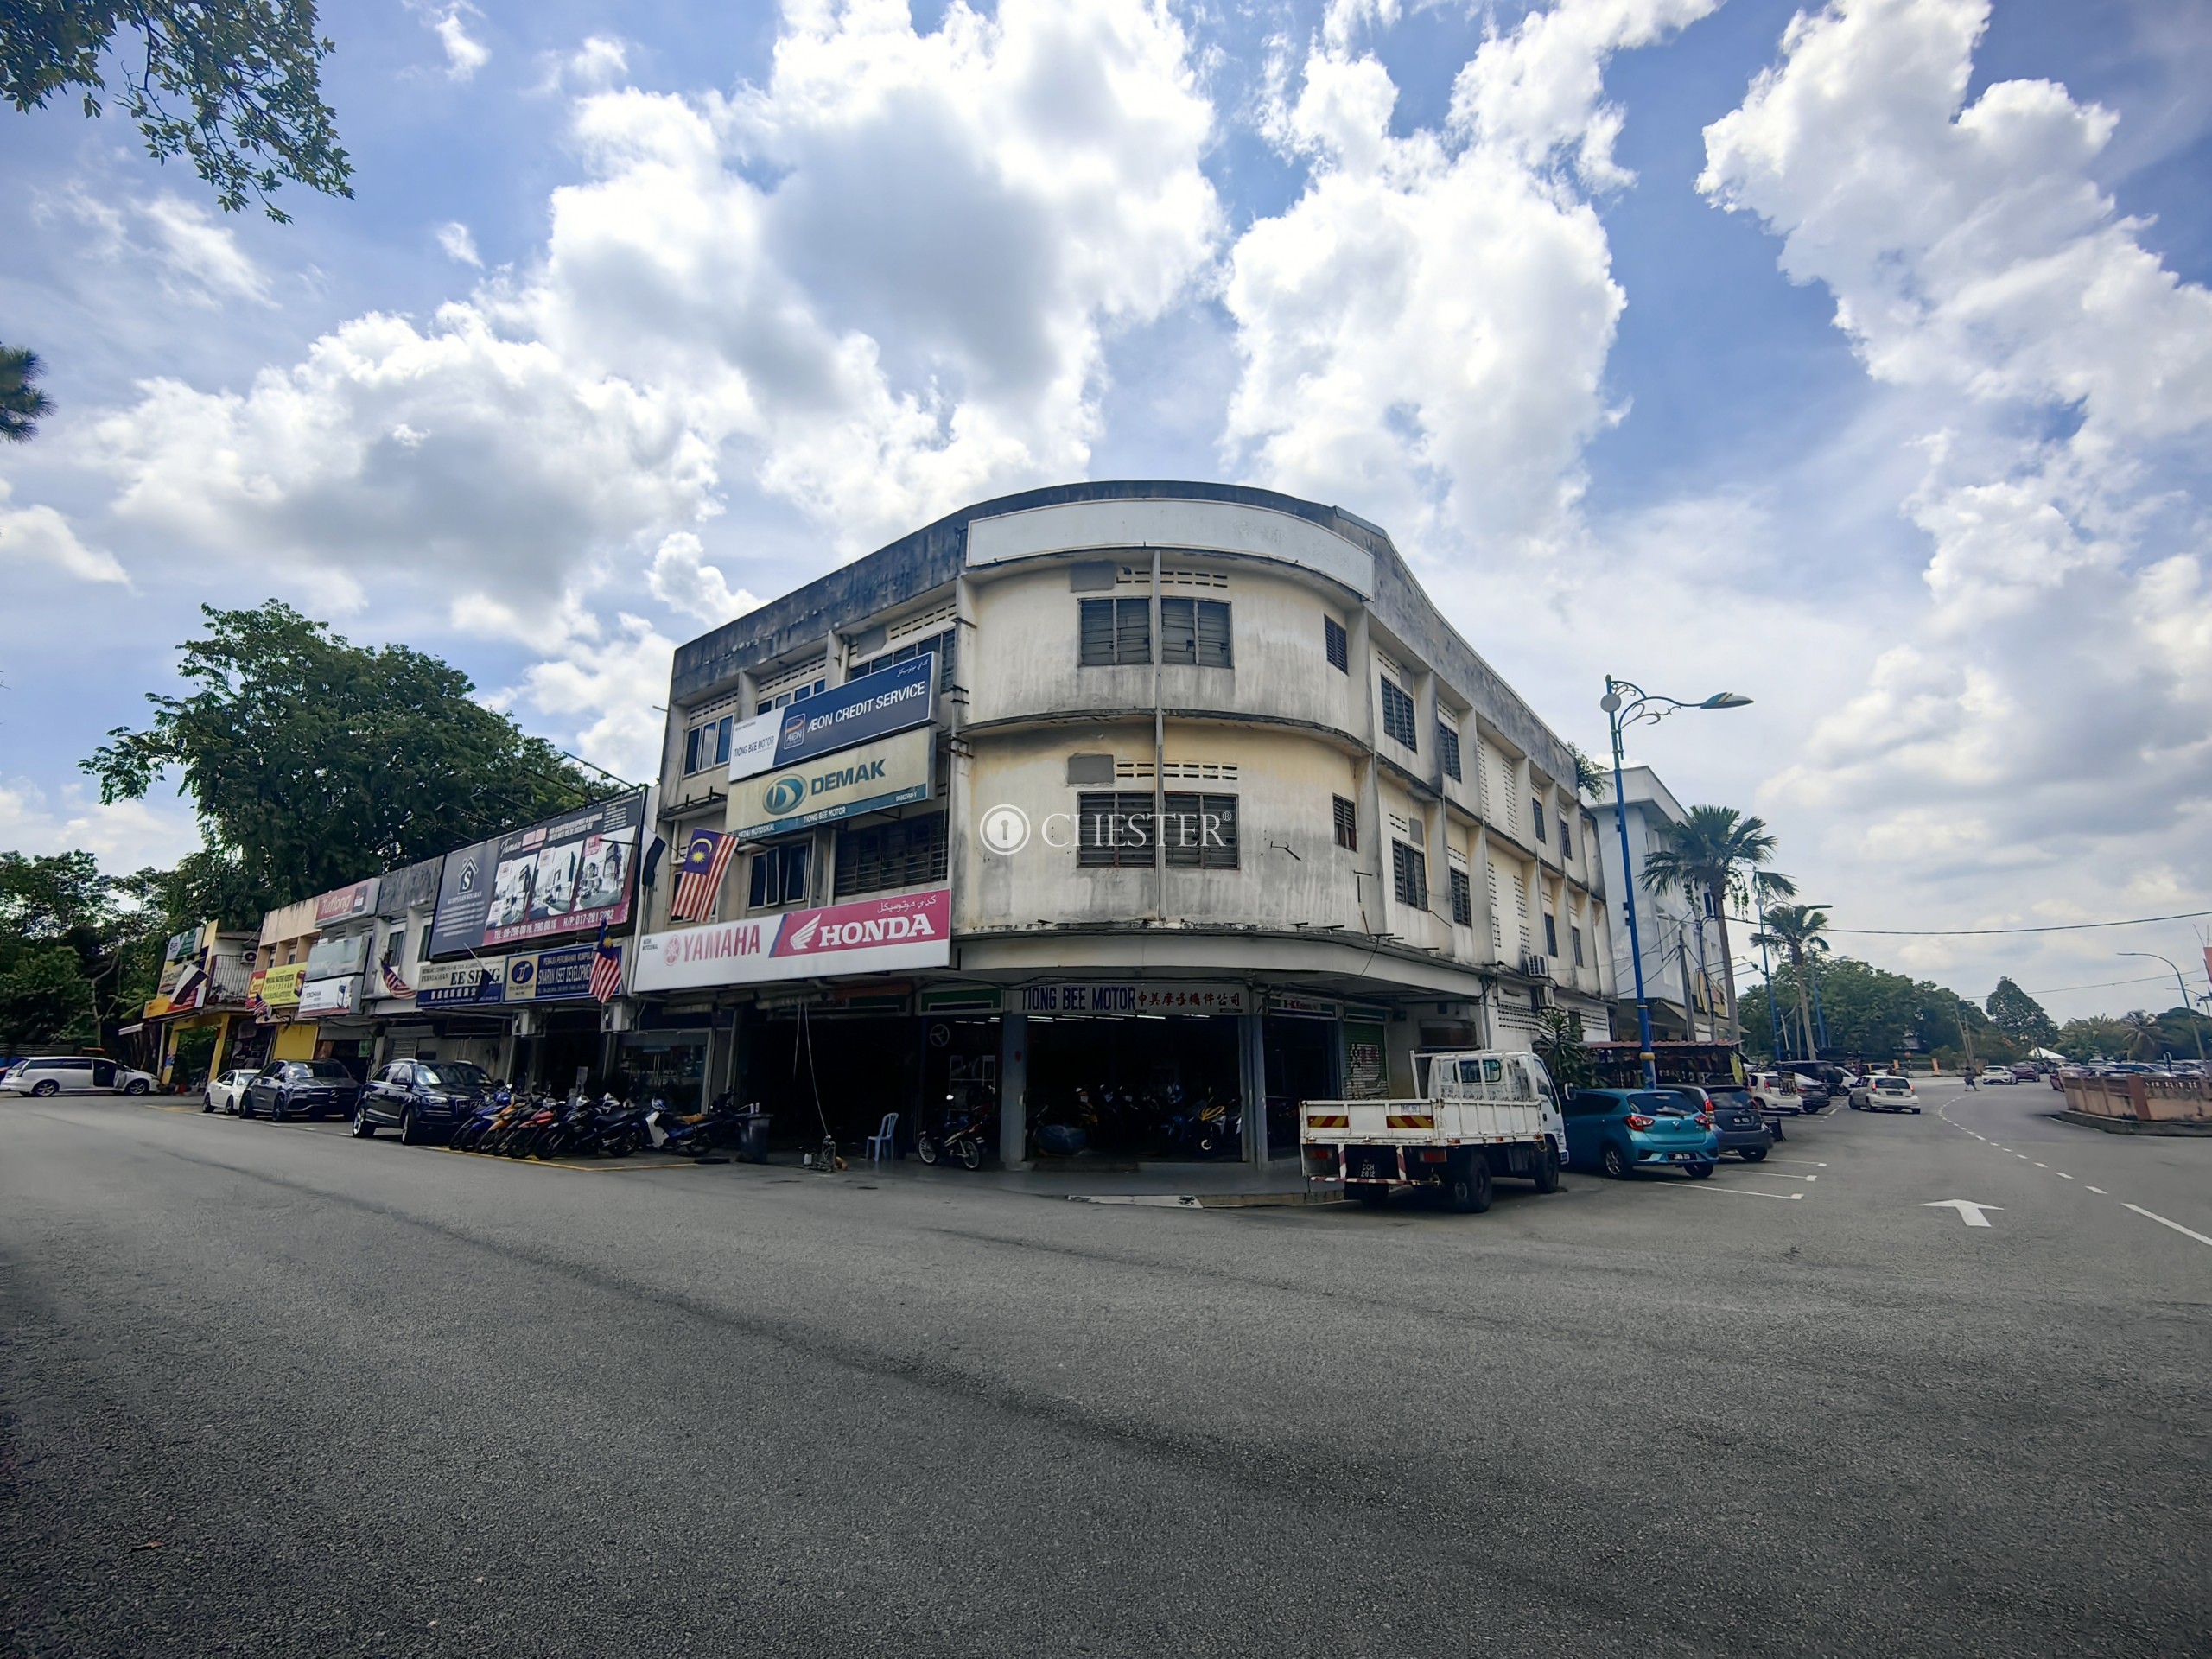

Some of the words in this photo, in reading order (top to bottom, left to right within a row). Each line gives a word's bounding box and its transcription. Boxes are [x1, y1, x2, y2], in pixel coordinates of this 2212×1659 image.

[836, 698, 874, 723] CREDIT
[875, 681, 925, 709] SERVICE
[734, 744, 748, 757] TIONG
[748, 741, 757, 753] BEE
[758, 735, 775, 750] MOTOR
[811, 759, 887, 796] DEMAK
[804, 814, 817, 824] TIONG
[818, 811, 828, 822] BEE
[829, 806, 846, 819] MOTOR
[751, 824, 775, 836] MOTOSIKAL
[819, 913, 935, 947] HONDA
[683, 924, 760, 962] YAMAHA
[450, 971, 466, 986] EE
[467, 968, 500, 984] SEG
[537, 969, 555, 985] SINARAN
[1021, 987, 1057, 1010] TIONG
[1063, 987, 1086, 1010] BEE
[1092, 987, 1136, 1010] MOTOR
